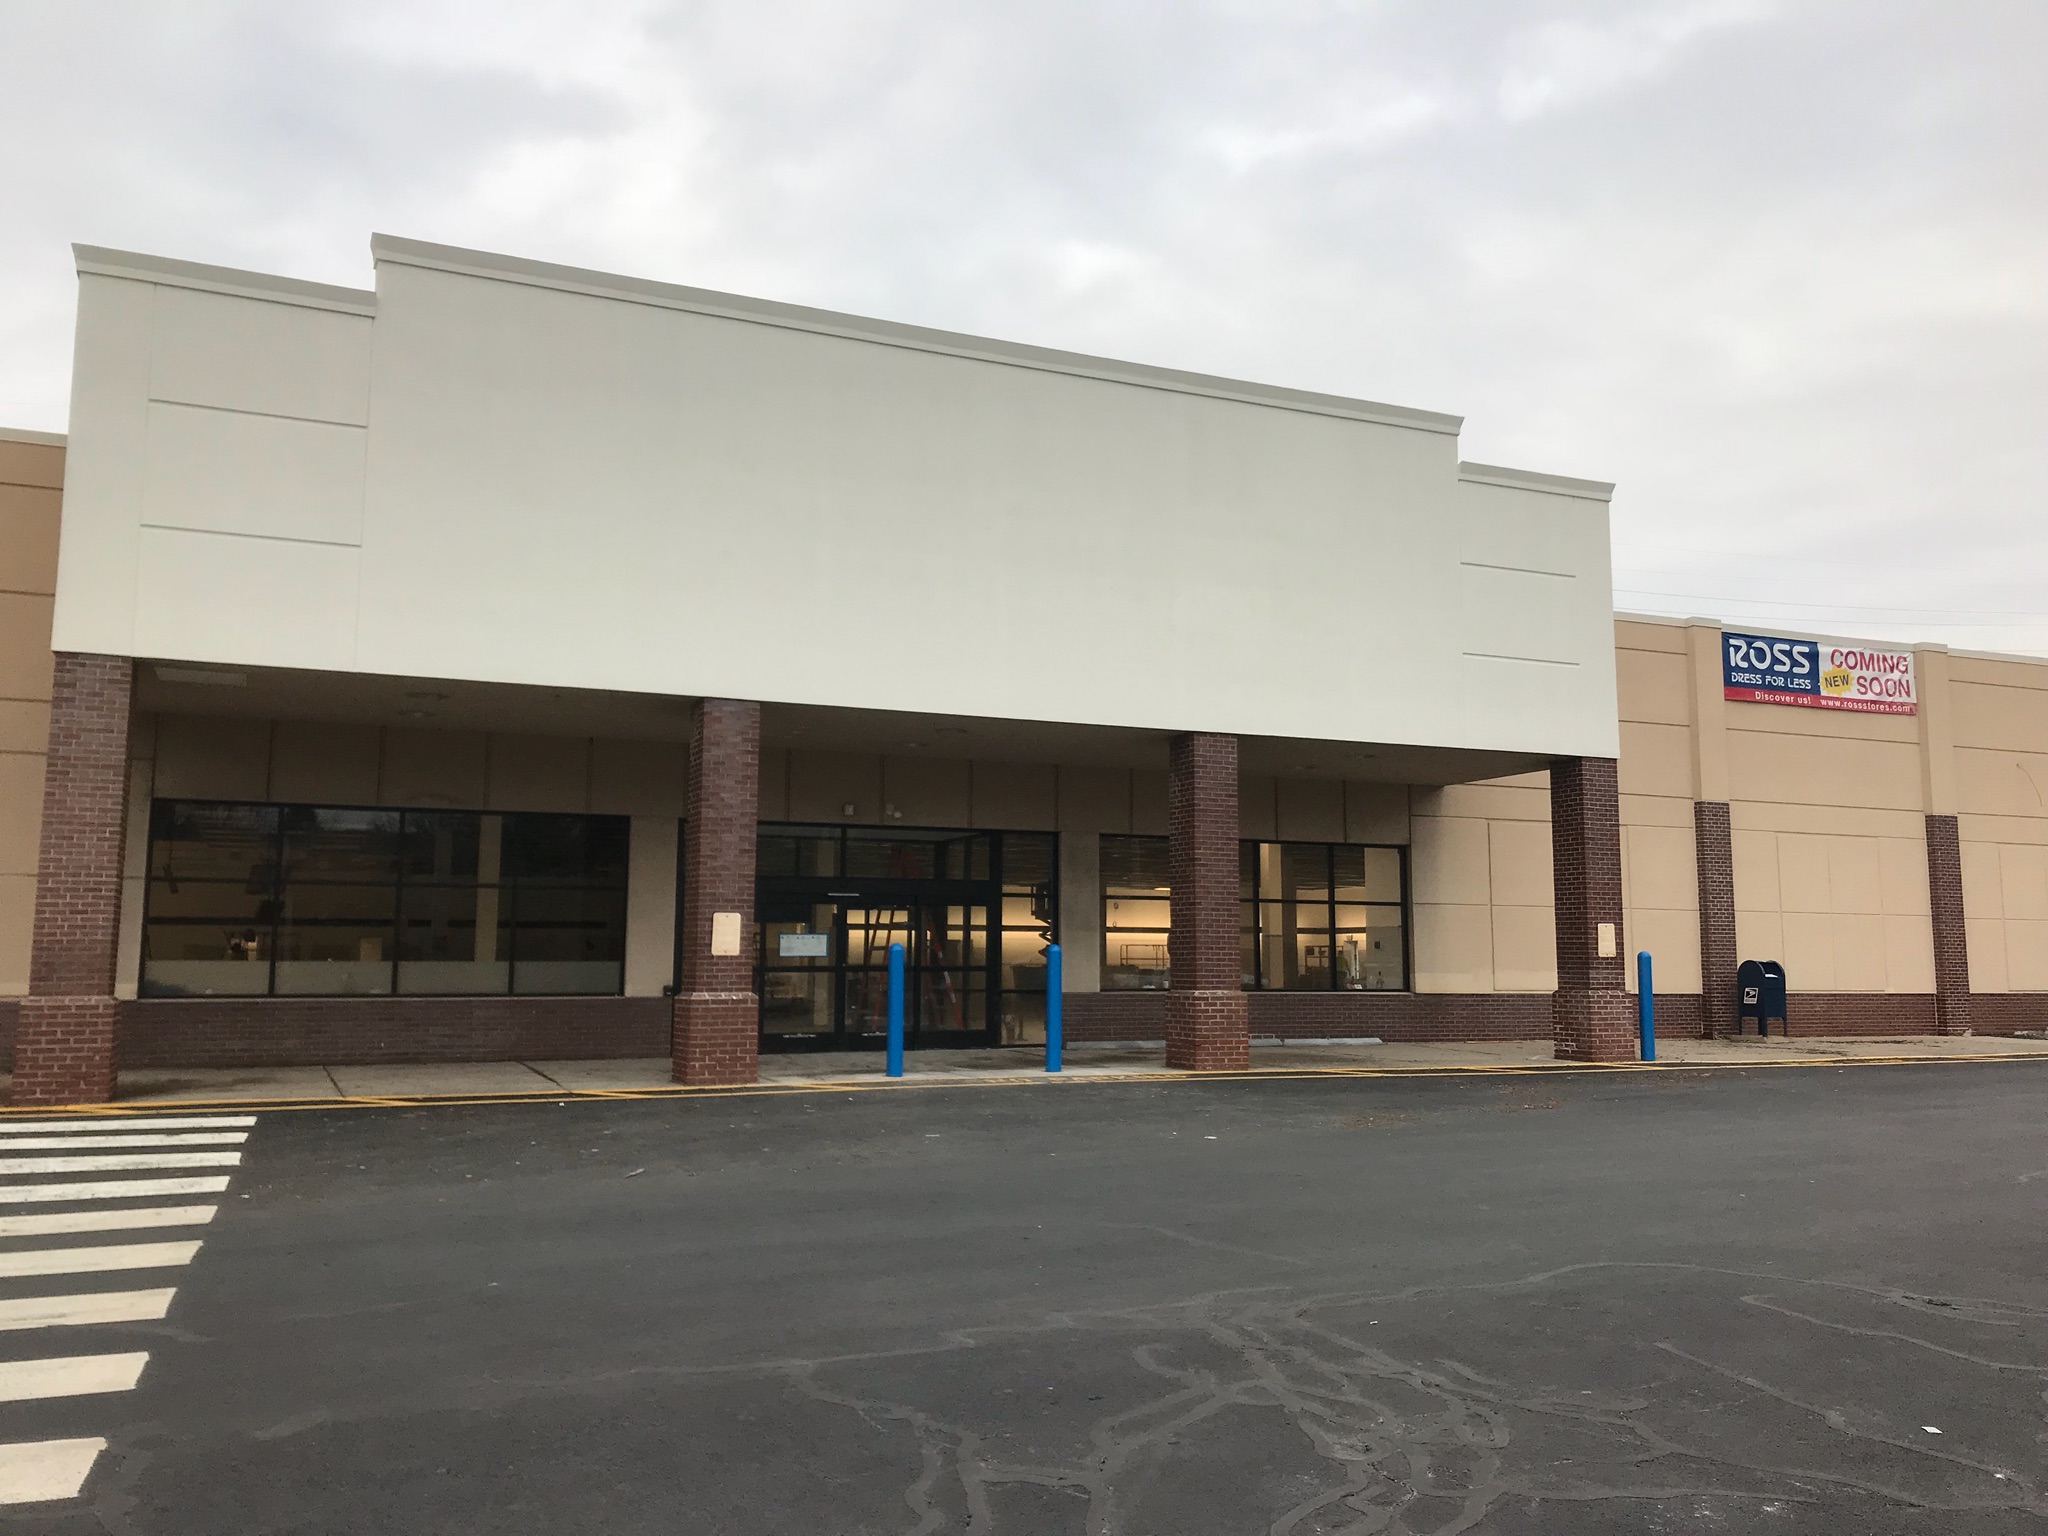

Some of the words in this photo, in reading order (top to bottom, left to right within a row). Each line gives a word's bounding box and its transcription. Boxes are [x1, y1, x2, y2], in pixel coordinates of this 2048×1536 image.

[1729, 638, 1810, 674] ROSS
[1830, 648, 1909, 675] COMING
[1731, 672, 1762, 685] DRESS
[1765, 675, 1785, 687] FOR
[1788, 678, 1811, 690] LESS
[1824, 674, 1849, 688] NEW
[1856, 675, 1911, 698] SOON
[1755, 691, 1794, 703] Discover
[1797, 696, 1811, 705] us!
[1820, 698, 1911, 713] www.rossstores.com
